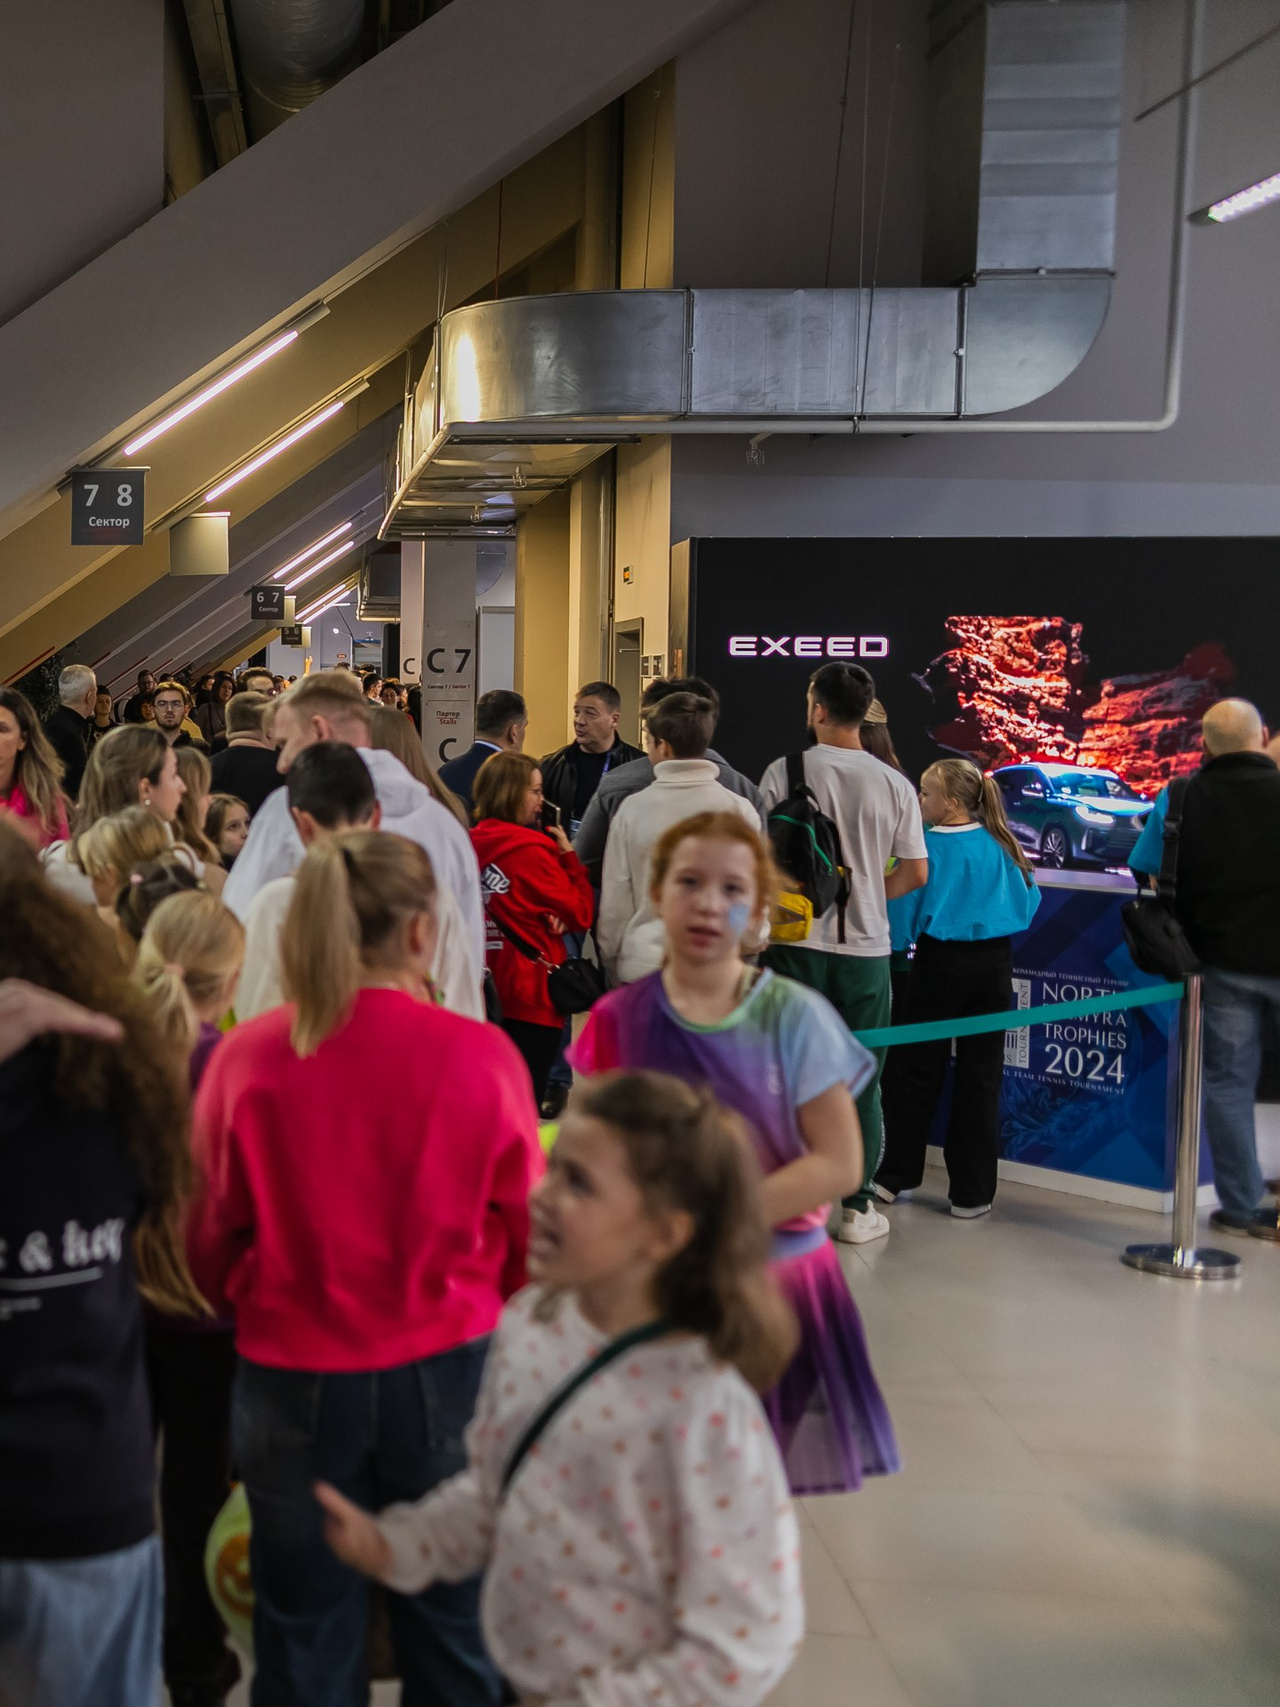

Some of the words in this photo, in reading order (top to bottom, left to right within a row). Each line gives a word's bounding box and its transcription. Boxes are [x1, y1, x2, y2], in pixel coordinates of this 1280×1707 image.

[83, 484, 99, 507] 7
[116, 483, 133, 507] 8
[88, 516, 130, 529] Сектор
[256, 592, 265, 603] 6
[272, 592, 280, 603] 7
[728, 636, 889, 658] EXEED
[454, 648, 472, 674] 7
[436, 710, 461, 718] Партер
[1042, 981, 1126, 1007] NORT
[1043, 1022, 1127, 1050] TROPHIES
[1044, 1043, 1125, 1085] 2024
[1014, 1070, 1035, 1081] TEAM
[1038, 1075, 1066, 1086] TENNIS
[1070, 1080, 1125, 1095] TOURNAMENT
